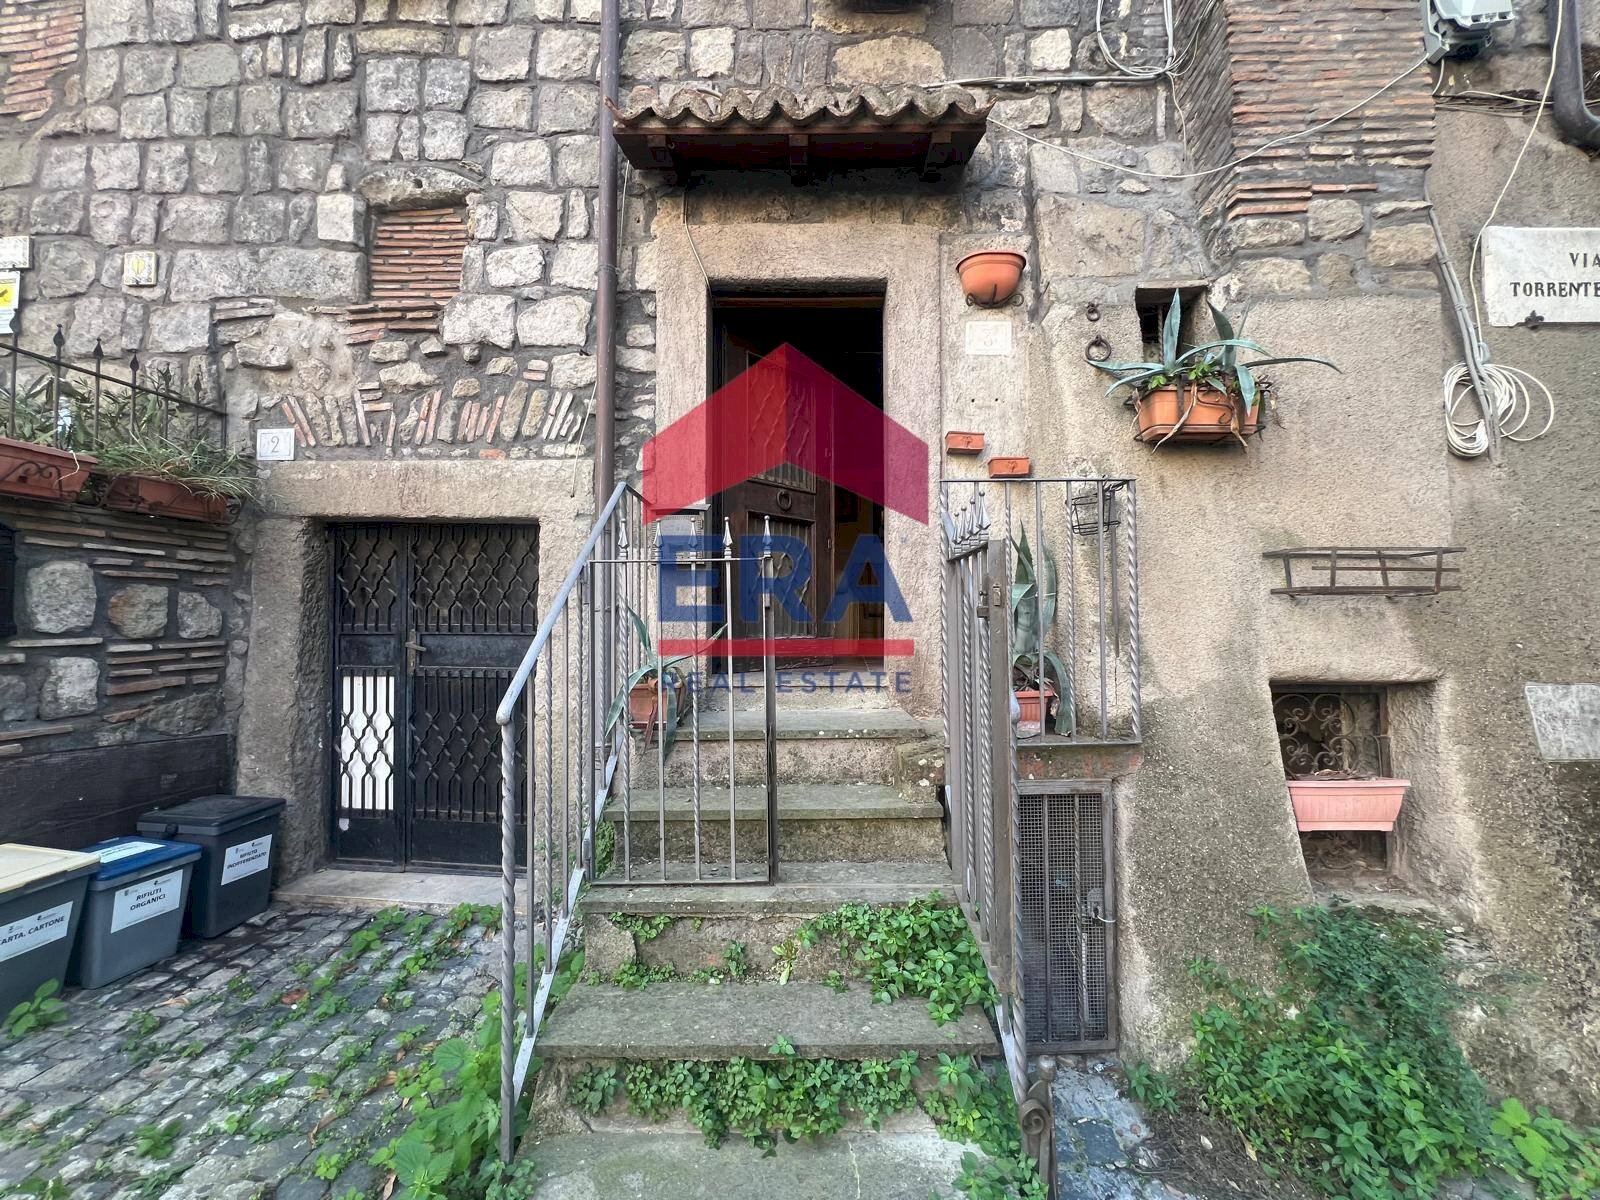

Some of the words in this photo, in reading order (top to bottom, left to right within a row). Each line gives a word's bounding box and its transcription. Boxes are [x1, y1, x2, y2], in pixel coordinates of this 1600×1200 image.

[1569, 253, 1600, 268] VIA
[271, 436, 280, 452] 2
[130, 894, 166, 910] ORGANICI
[136, 888, 162, 901] RIFIUTI
[28, 916, 65, 935] CARTONE
